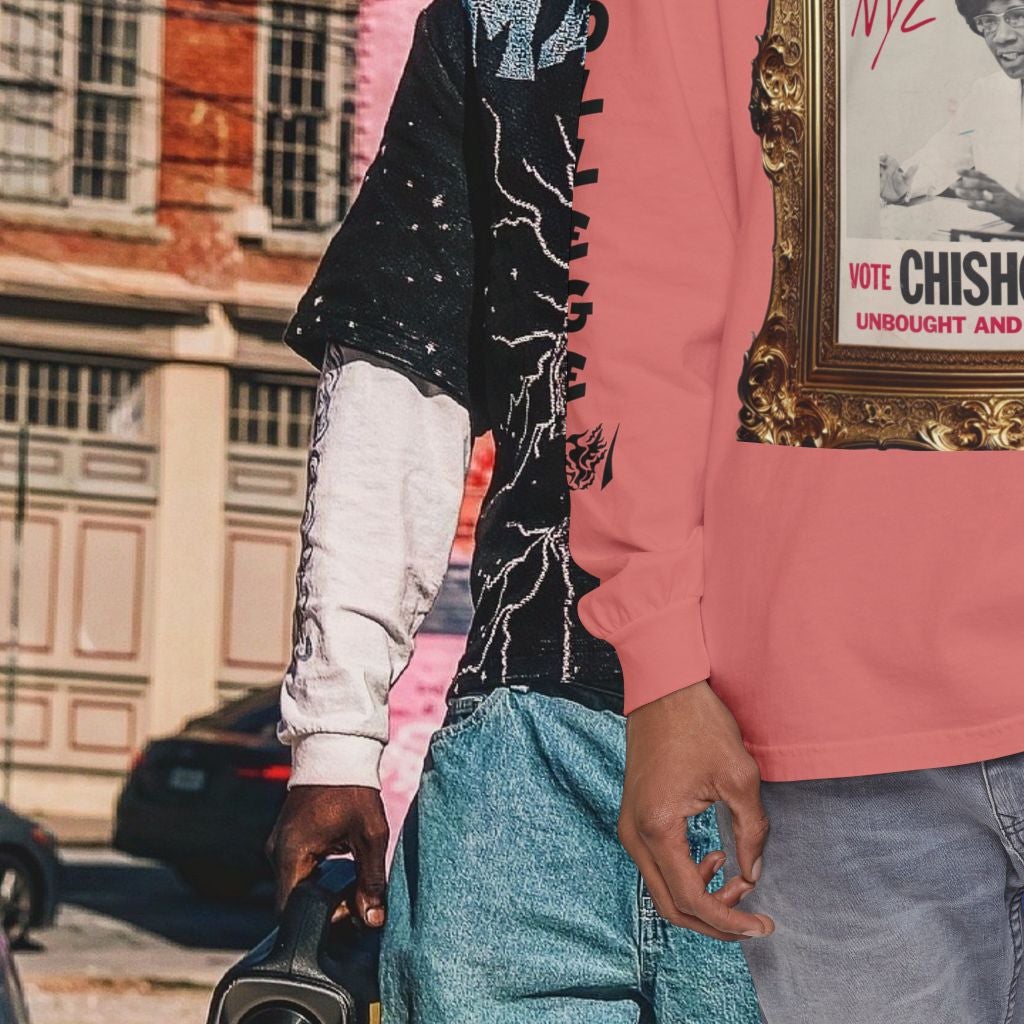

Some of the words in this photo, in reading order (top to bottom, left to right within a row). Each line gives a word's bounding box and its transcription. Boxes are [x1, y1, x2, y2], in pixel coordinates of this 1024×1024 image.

[849, 262, 892, 291] VOTE
[856, 312, 967, 334] UNBOUGHT
[974, 315, 1023, 334] AND
